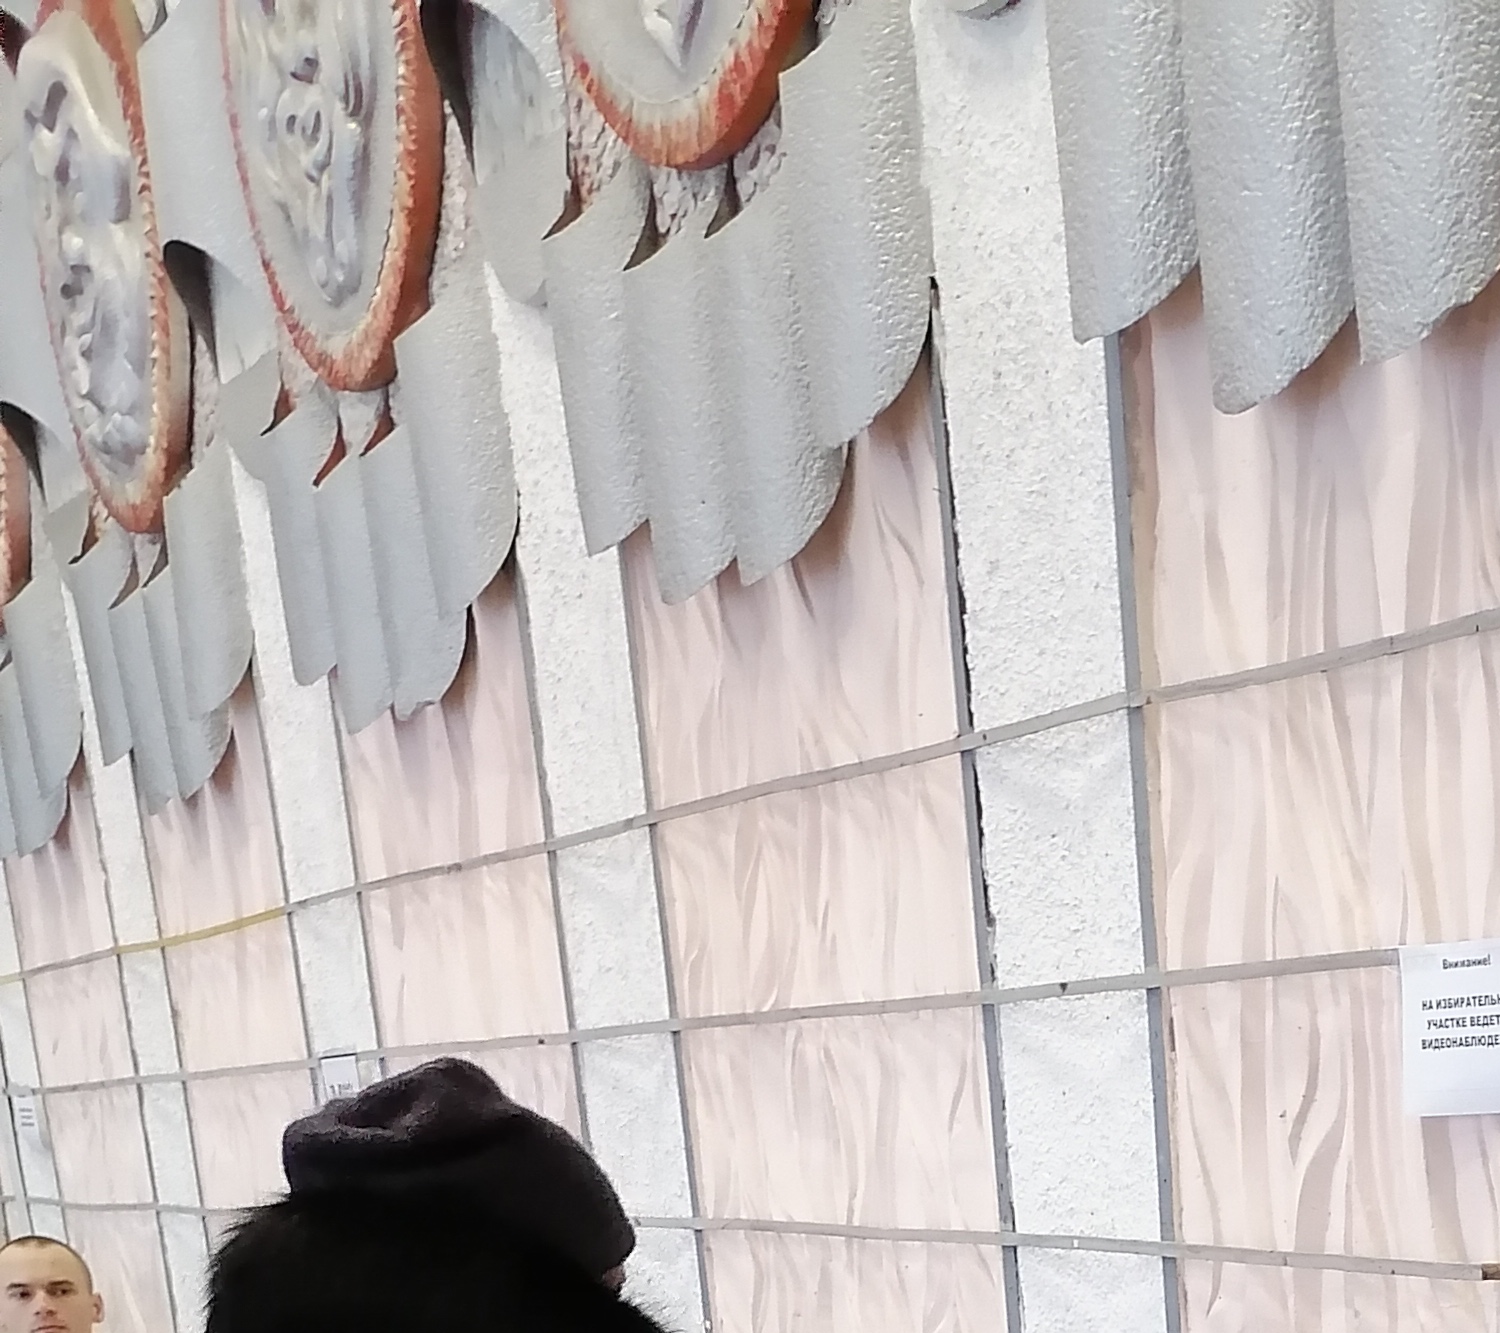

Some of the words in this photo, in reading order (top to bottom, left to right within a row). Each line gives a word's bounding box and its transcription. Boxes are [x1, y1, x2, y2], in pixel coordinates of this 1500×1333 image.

[1441, 953, 1492, 971] Внимание!
[1421, 998, 1434, 1011] НА
[1426, 1016, 1468, 1031] УЧАСТКЕ
